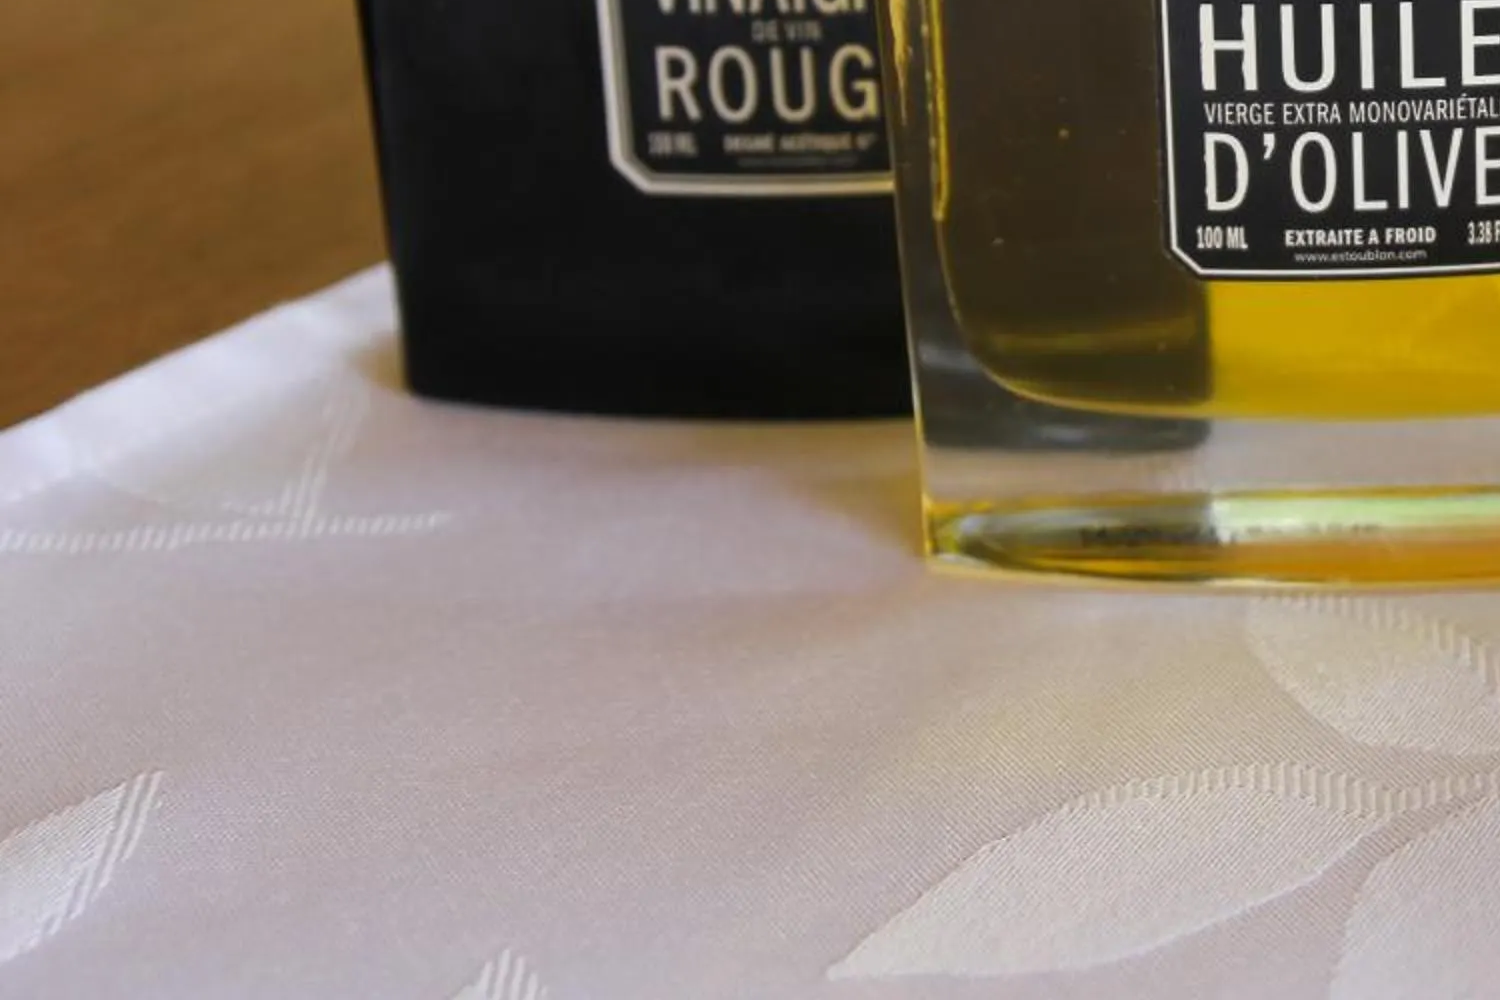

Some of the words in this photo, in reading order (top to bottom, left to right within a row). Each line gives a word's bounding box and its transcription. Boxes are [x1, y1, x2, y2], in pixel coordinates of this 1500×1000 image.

[654, 44, 879, 123] ROUG
[1203, 102, 1275, 126] VIERGE
[1282, 101, 1342, 125] EXTRA
[1197, 226, 1224, 249] 100
[1226, 226, 1248, 249] ML
[1285, 229, 1364, 247] EXTRAITE
[1368, 229, 1380, 246] A
[1385, 226, 1437, 244] FROID
[1467, 221, 1493, 245] 3.38
[1294, 249, 1428, 263] www.estoublon.com
